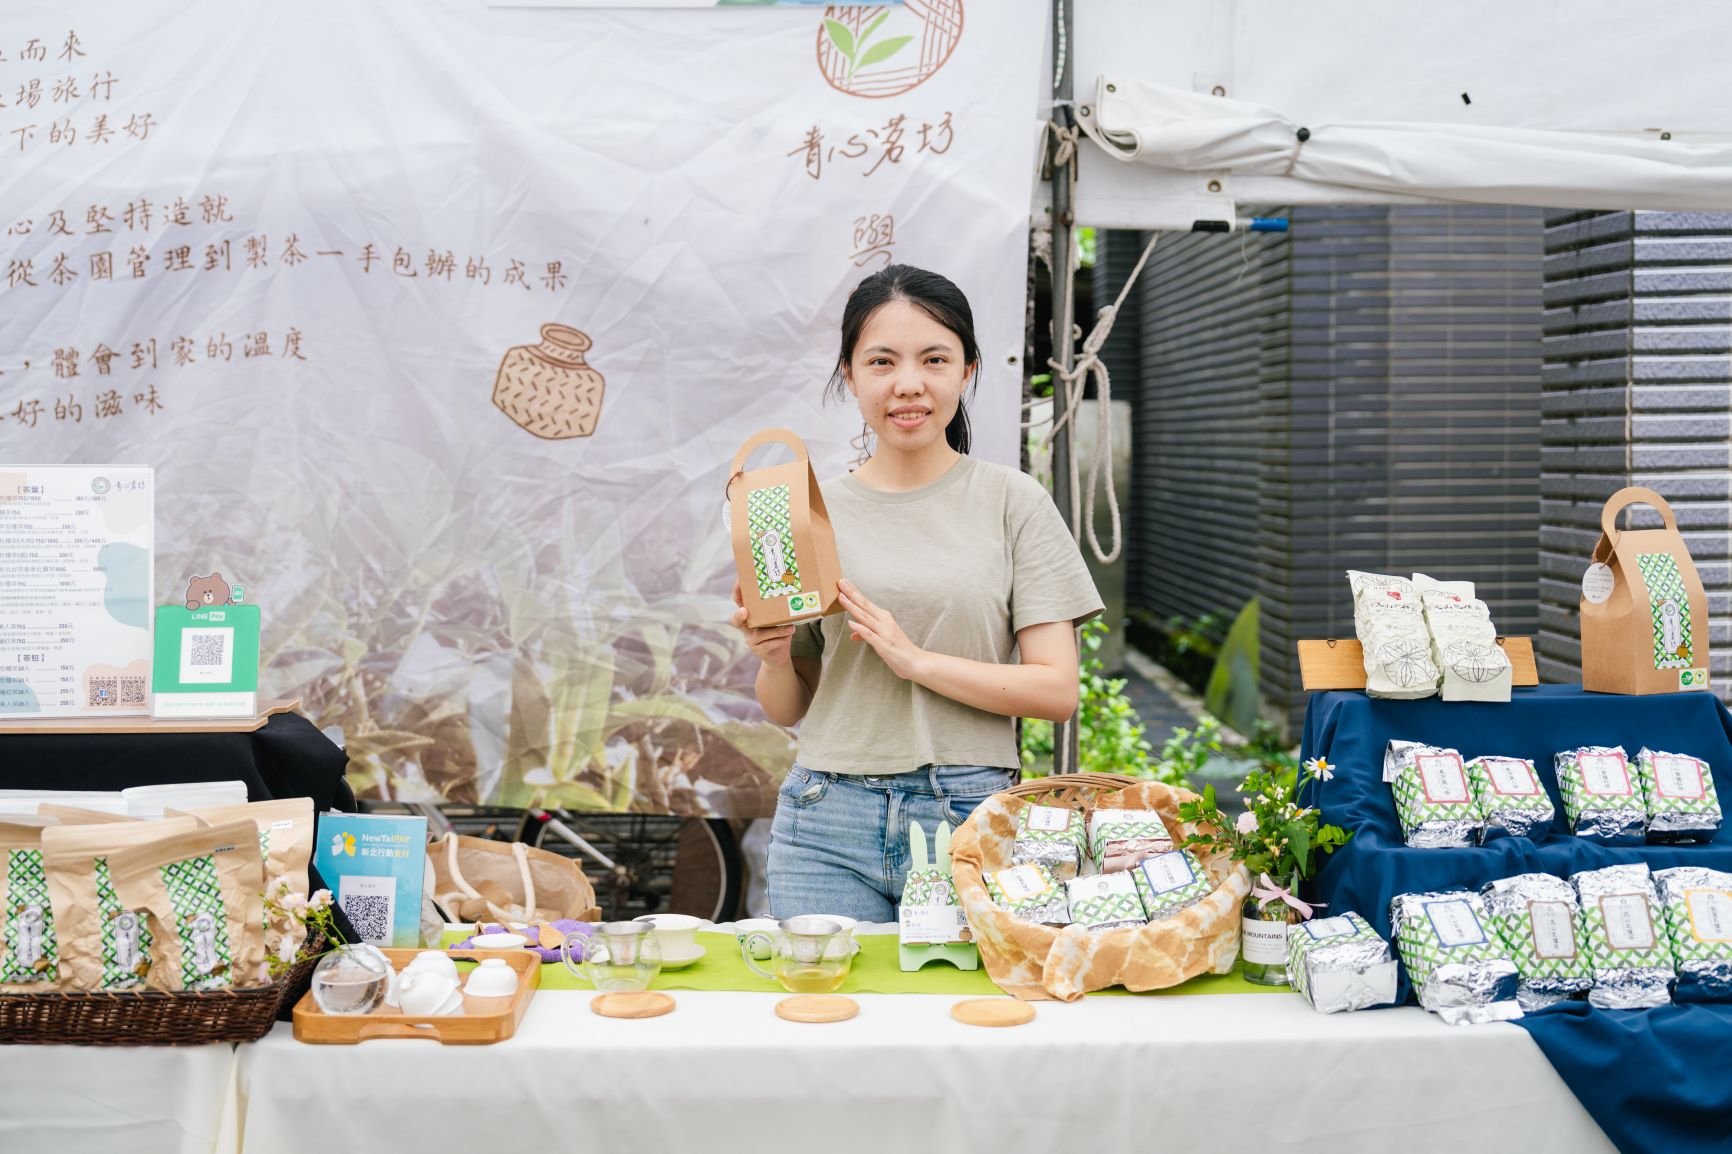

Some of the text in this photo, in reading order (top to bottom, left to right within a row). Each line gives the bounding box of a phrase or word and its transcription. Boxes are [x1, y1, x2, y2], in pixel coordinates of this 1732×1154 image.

[0, 30, 87, 62] 而來
[0, 70, 119, 109] 場旅行
[11, 113, 157, 151] 下的美好
[787, 111, 953, 180] 青心茗坊
[8, 194, 234, 236] 心及堅持造就
[7, 232, 568, 291] 從茶園管理到製茶一手包辦的成果
[0, 326, 307, 379] ，體會到家的溫度
[0, 384, 163, 428] 好的滋味
